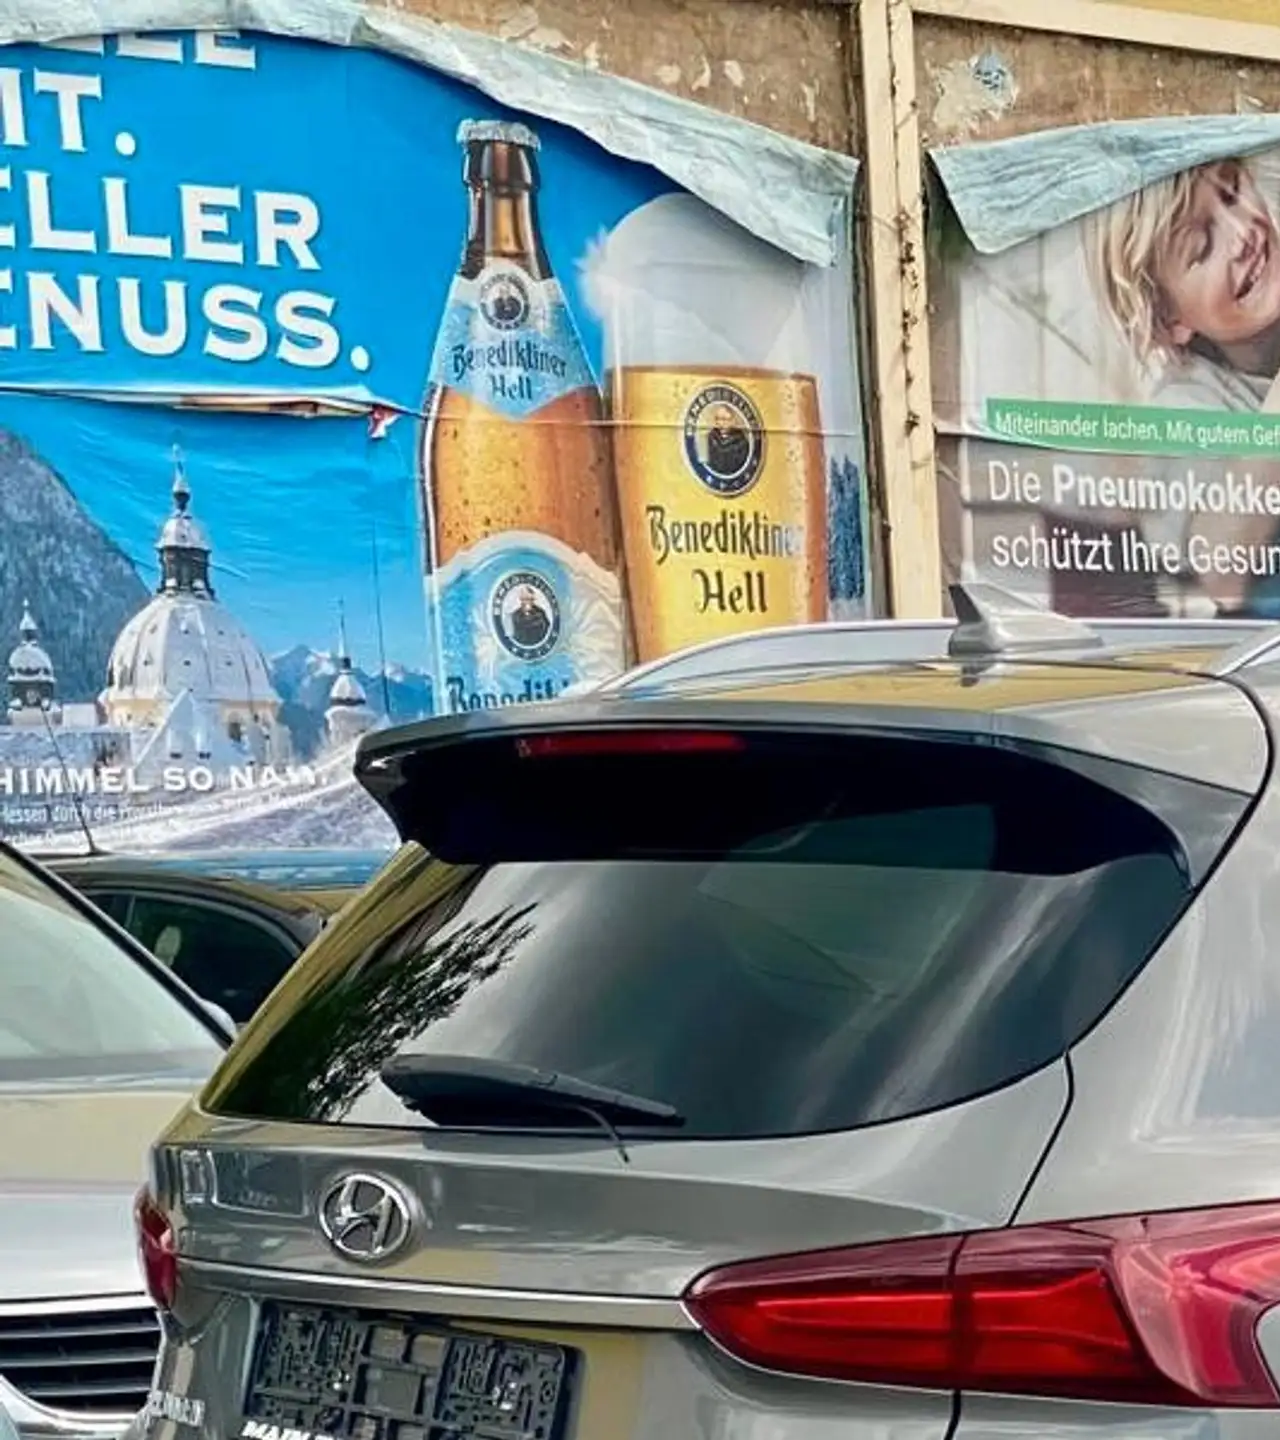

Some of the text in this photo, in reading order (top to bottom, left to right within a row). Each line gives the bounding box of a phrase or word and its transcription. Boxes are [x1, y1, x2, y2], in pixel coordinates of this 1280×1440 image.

[0, 67, 136, 156] T.
[0, 164, 321, 270] LLER
[0, 268, 371, 372] NUSS.
[451, 340, 567, 381] Benediktiner
[490, 374, 534, 400] Hell
[995, 411, 1098, 435] Miteinander
[1104, 415, 1162, 441] lachen.
[1166, 420, 1193, 442] Mit
[1199, 423, 1249, 448] gutem
[988, 460, 1041, 502] Die
[992, 528, 1112, 574] schützt
[1121, 531, 1180, 575] Ihre
[692, 568, 768, 614] Hell
[163, 766, 213, 792] SO
